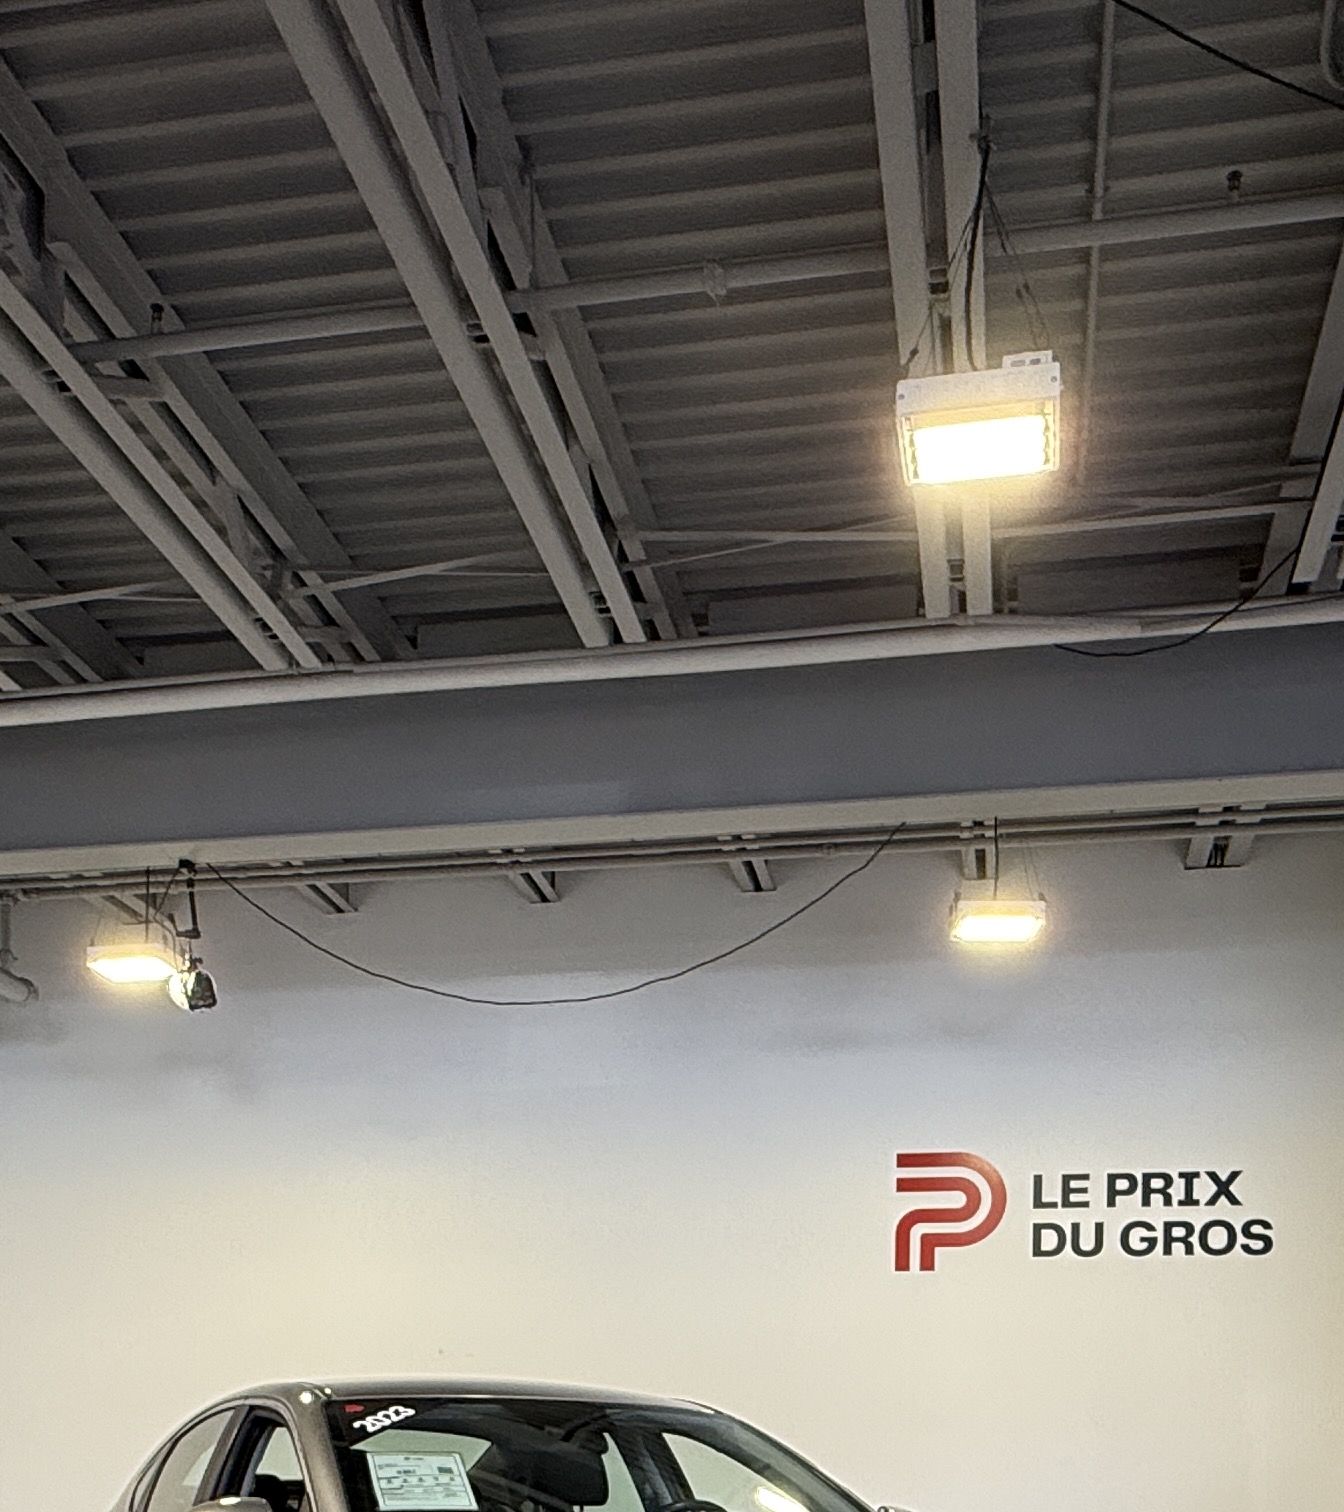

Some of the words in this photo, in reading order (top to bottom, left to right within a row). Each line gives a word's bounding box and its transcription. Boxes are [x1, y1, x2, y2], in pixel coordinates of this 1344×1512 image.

[1032, 1173, 1090, 1210] LE
[1106, 1170, 1243, 1208] PRIX
[1032, 1222, 1104, 1258] DU
[1120, 1218, 1274, 1257] GROS
